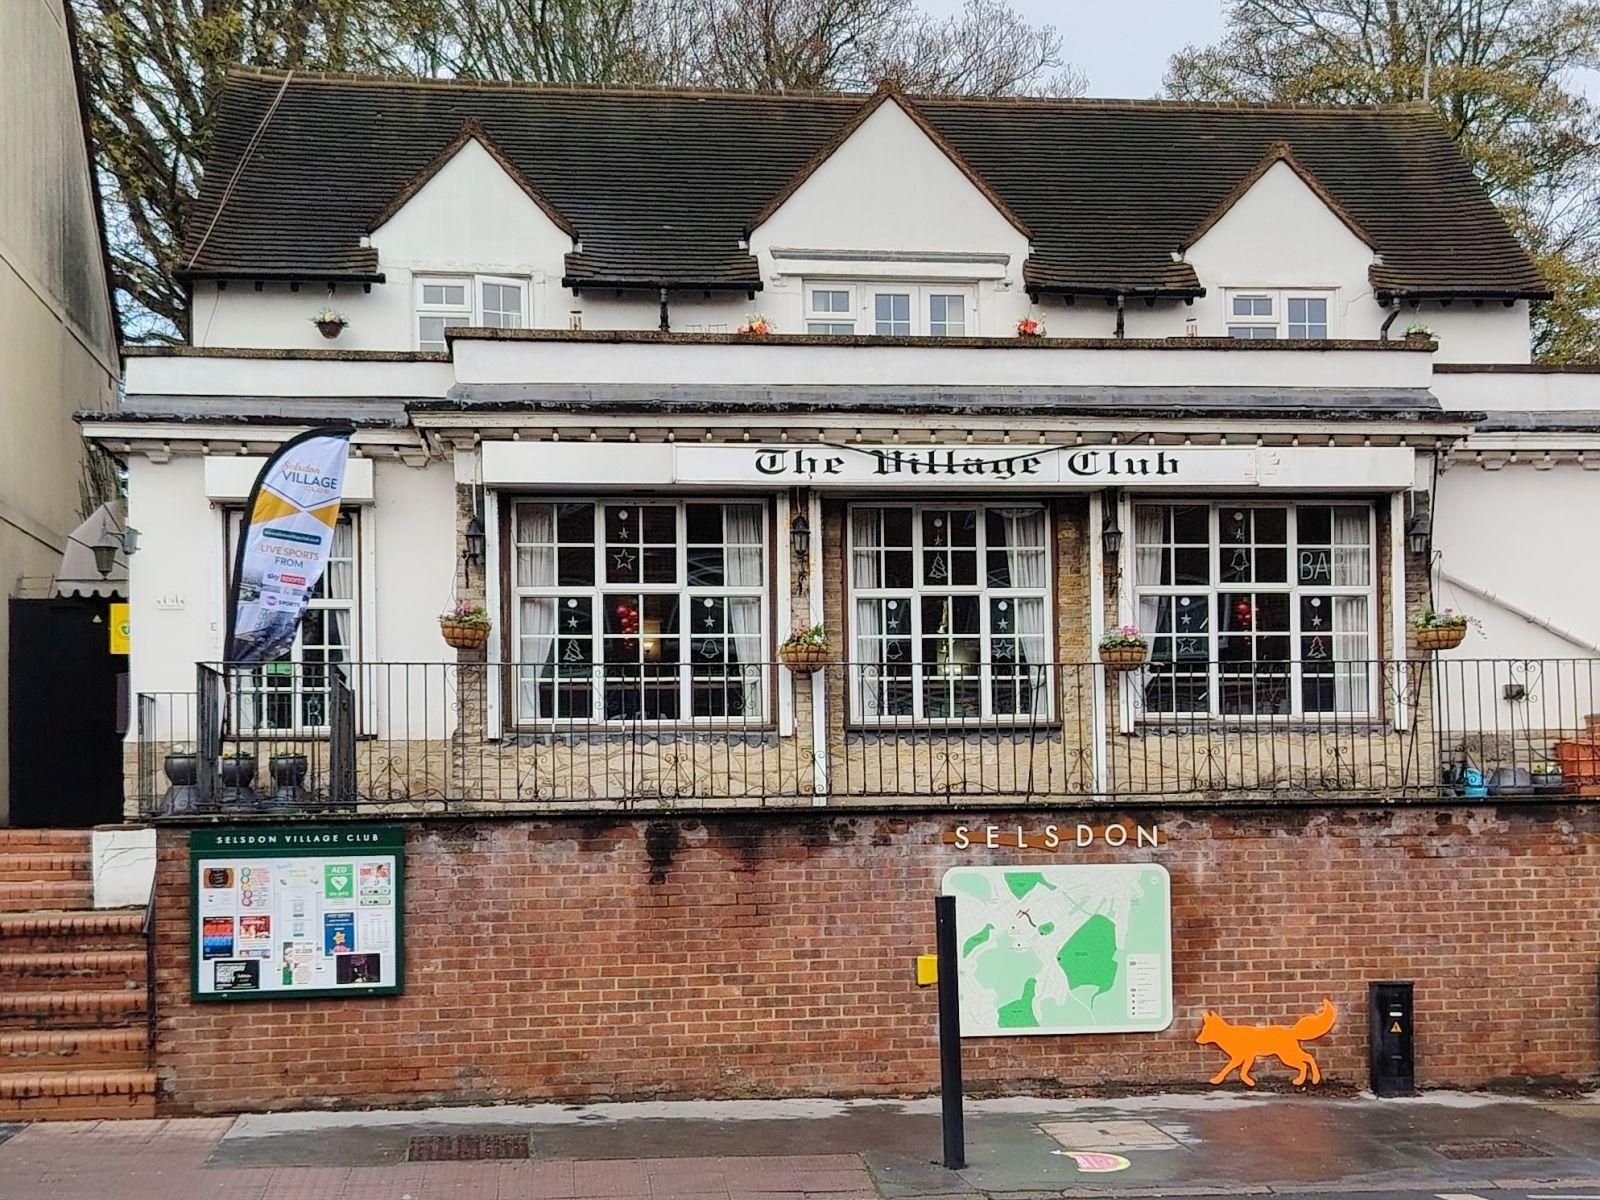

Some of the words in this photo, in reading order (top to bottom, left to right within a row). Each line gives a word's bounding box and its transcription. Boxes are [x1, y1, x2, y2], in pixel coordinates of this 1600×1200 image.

[755, 448, 845, 480] The
[872, 448, 1042, 480] Village
[1067, 449, 1180, 476] Club
[282, 470, 338, 490] VILLAGE
[261, 544, 282, 556] LIVE
[282, 547, 320, 561] SPORTS
[274, 556, 304, 568] FROM
[215, 835, 277, 845] SELSDON
[285, 834, 339, 844] VILLAGE
[346, 833, 380, 843] CLUB
[954, 823, 1159, 850] SELSDON
[331, 866, 347, 874] AED
